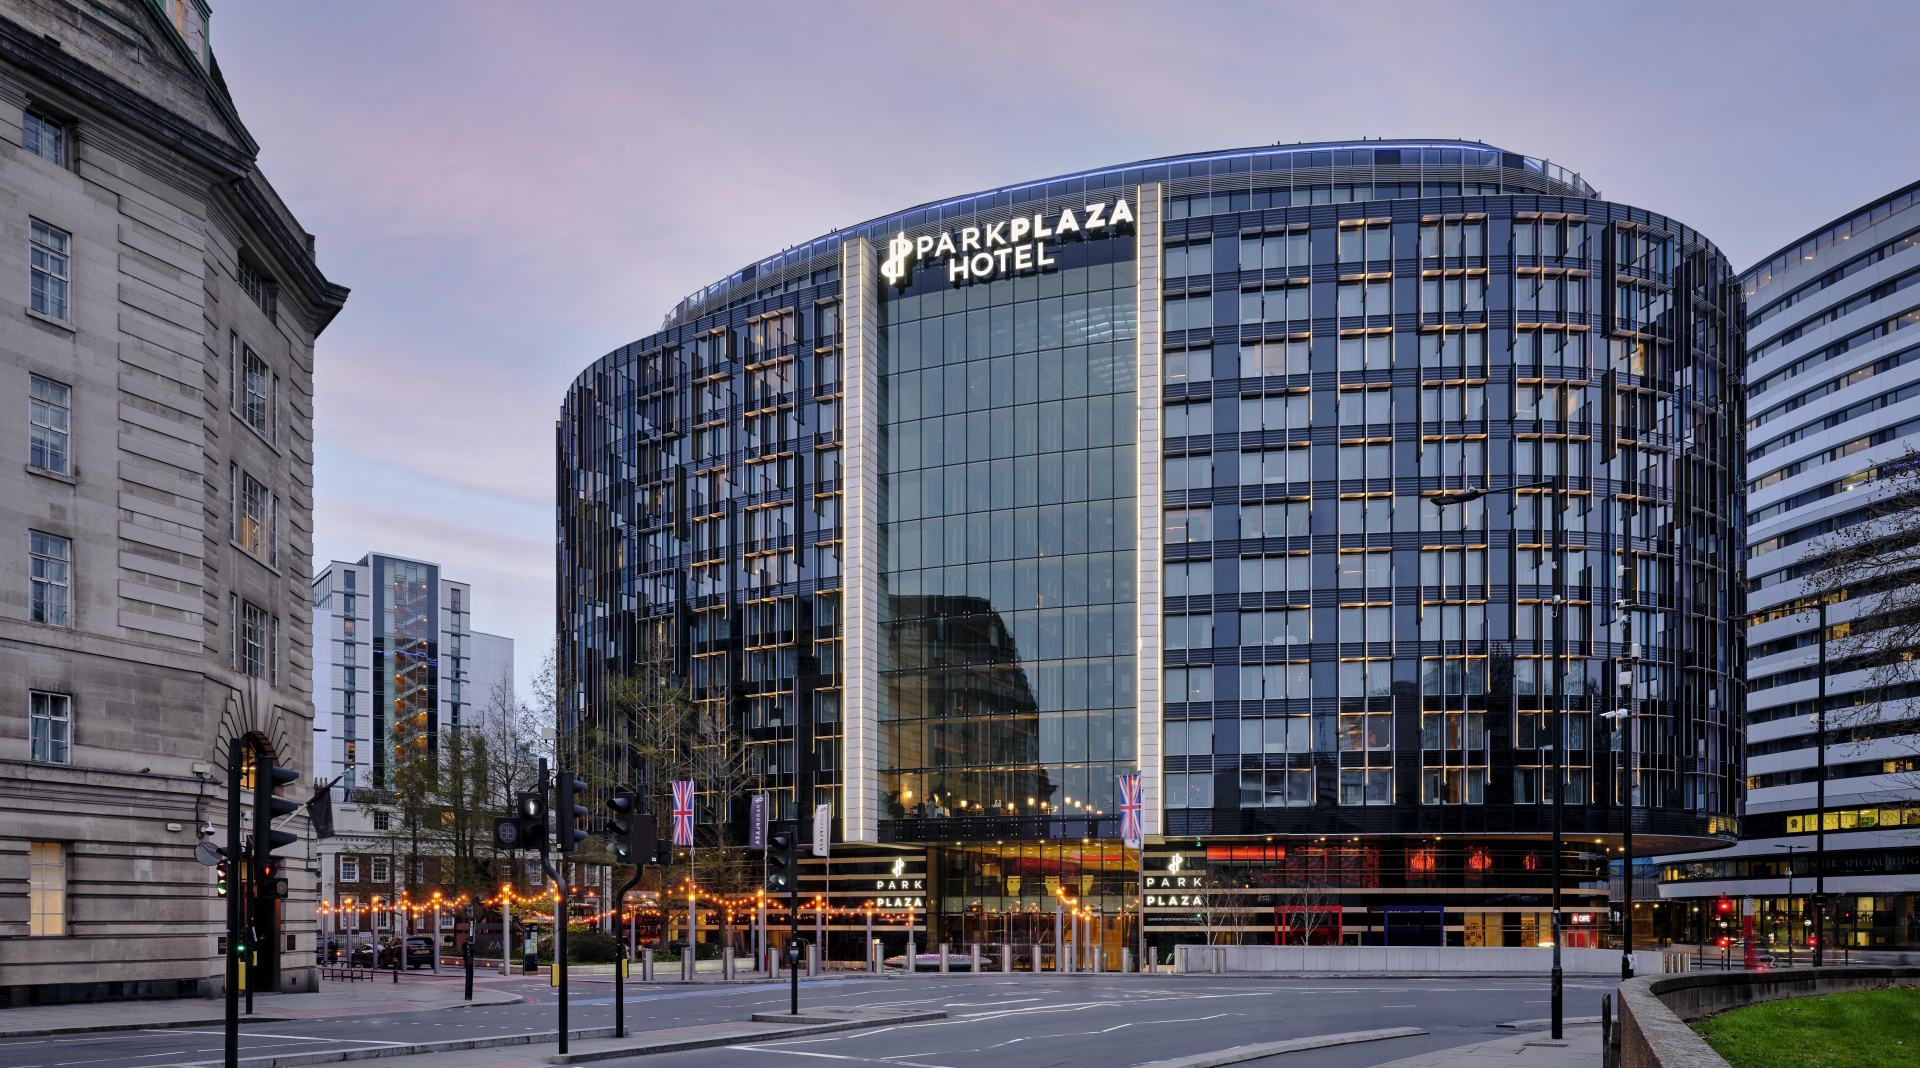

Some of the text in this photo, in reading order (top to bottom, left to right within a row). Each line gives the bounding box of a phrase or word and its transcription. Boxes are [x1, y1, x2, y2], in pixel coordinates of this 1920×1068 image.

[917, 199, 1134, 260] PARKPLAZA
[950, 242, 1055, 282] HOTEL
[1797, 859, 1840, 869] WINER:
[1845, 857, 1884, 867] SPECIAL
[877, 880, 922, 890] PARK
[1147, 878, 1202, 887] PARK
[877, 897, 922, 907] PLAZA
[1147, 896, 1202, 905] PLAZA
